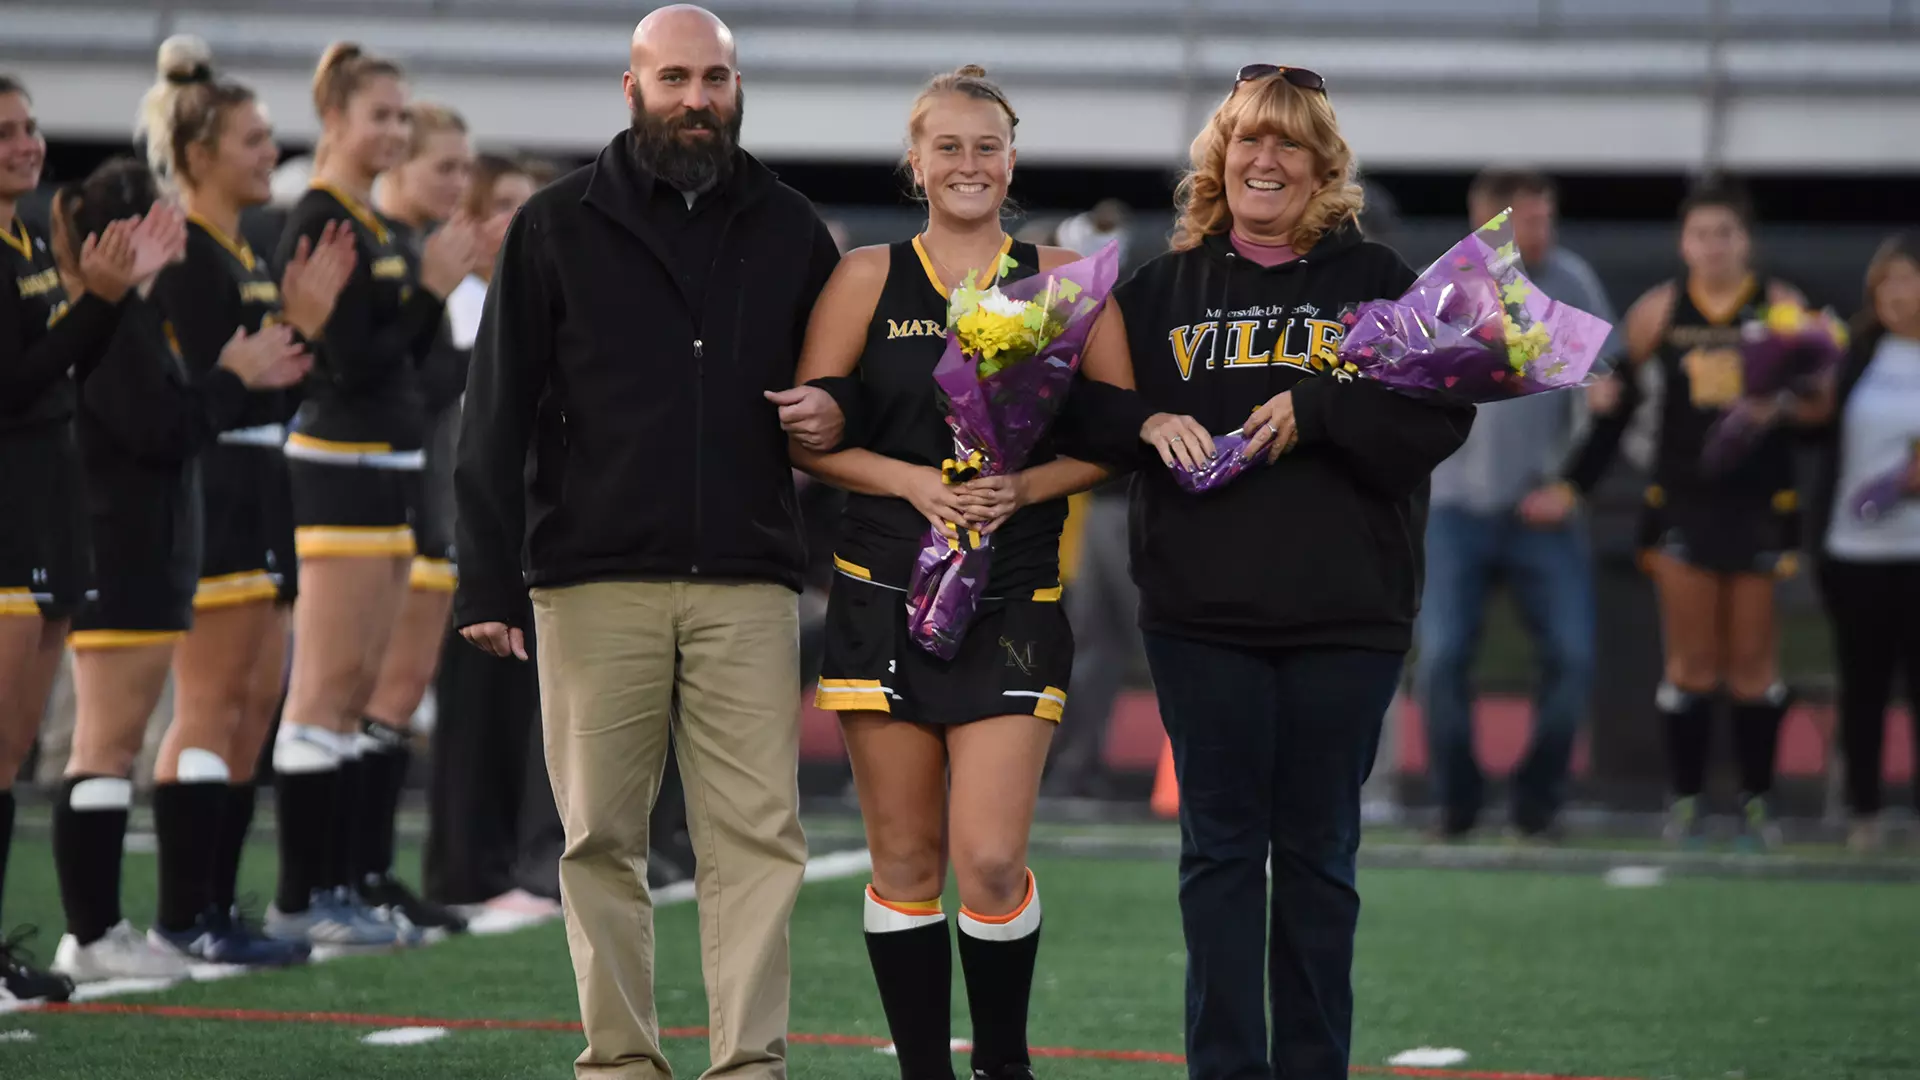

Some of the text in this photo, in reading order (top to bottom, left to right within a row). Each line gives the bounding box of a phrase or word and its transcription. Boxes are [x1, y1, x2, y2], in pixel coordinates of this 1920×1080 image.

[1205, 303, 1320, 318] Miersville Unrsity
[887, 318, 947, 339] MAR
